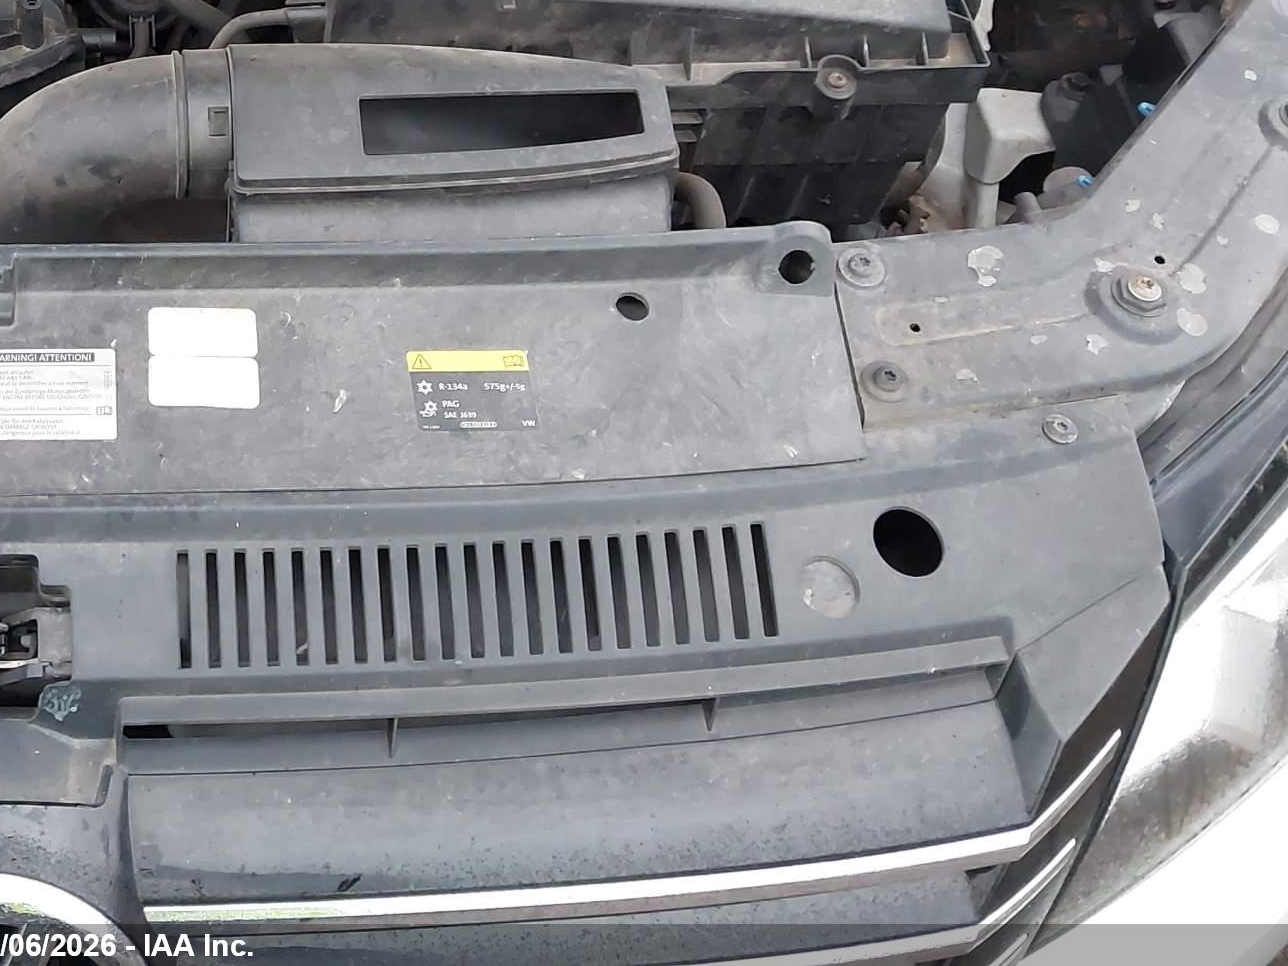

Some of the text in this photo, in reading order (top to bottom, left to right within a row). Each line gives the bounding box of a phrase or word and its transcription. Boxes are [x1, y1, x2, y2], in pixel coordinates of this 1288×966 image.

[39, 352, 92, 362] ATTENTION!
[438, 382, 468, 391] R-134a
[441, 400, 460, 408] PAG
[444, 411, 458, 419] SAE
[521, 419, 537, 427] VW
